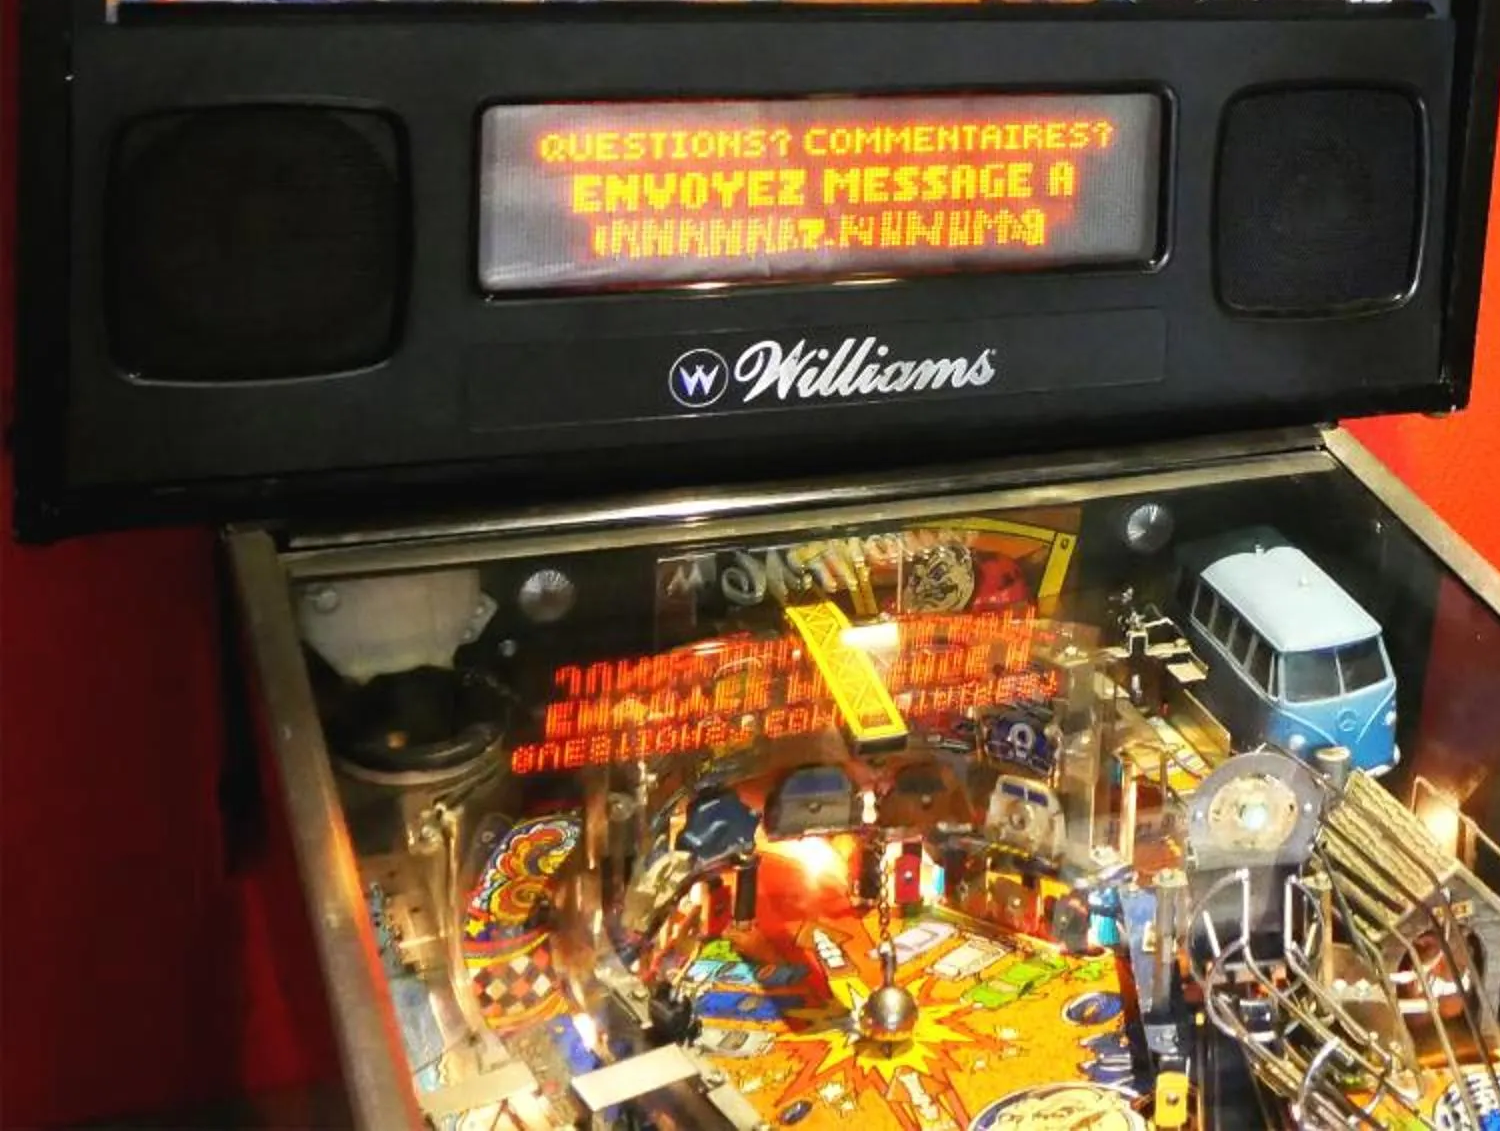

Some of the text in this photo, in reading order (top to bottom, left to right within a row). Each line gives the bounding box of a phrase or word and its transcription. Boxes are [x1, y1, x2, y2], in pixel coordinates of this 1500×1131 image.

[540, 121, 1114, 162] QUESTIONS? COMMENTAIRES?
[573, 160, 1076, 213] ENVOYEZ MESSAGE A
[734, 336, 996, 403] Williams
